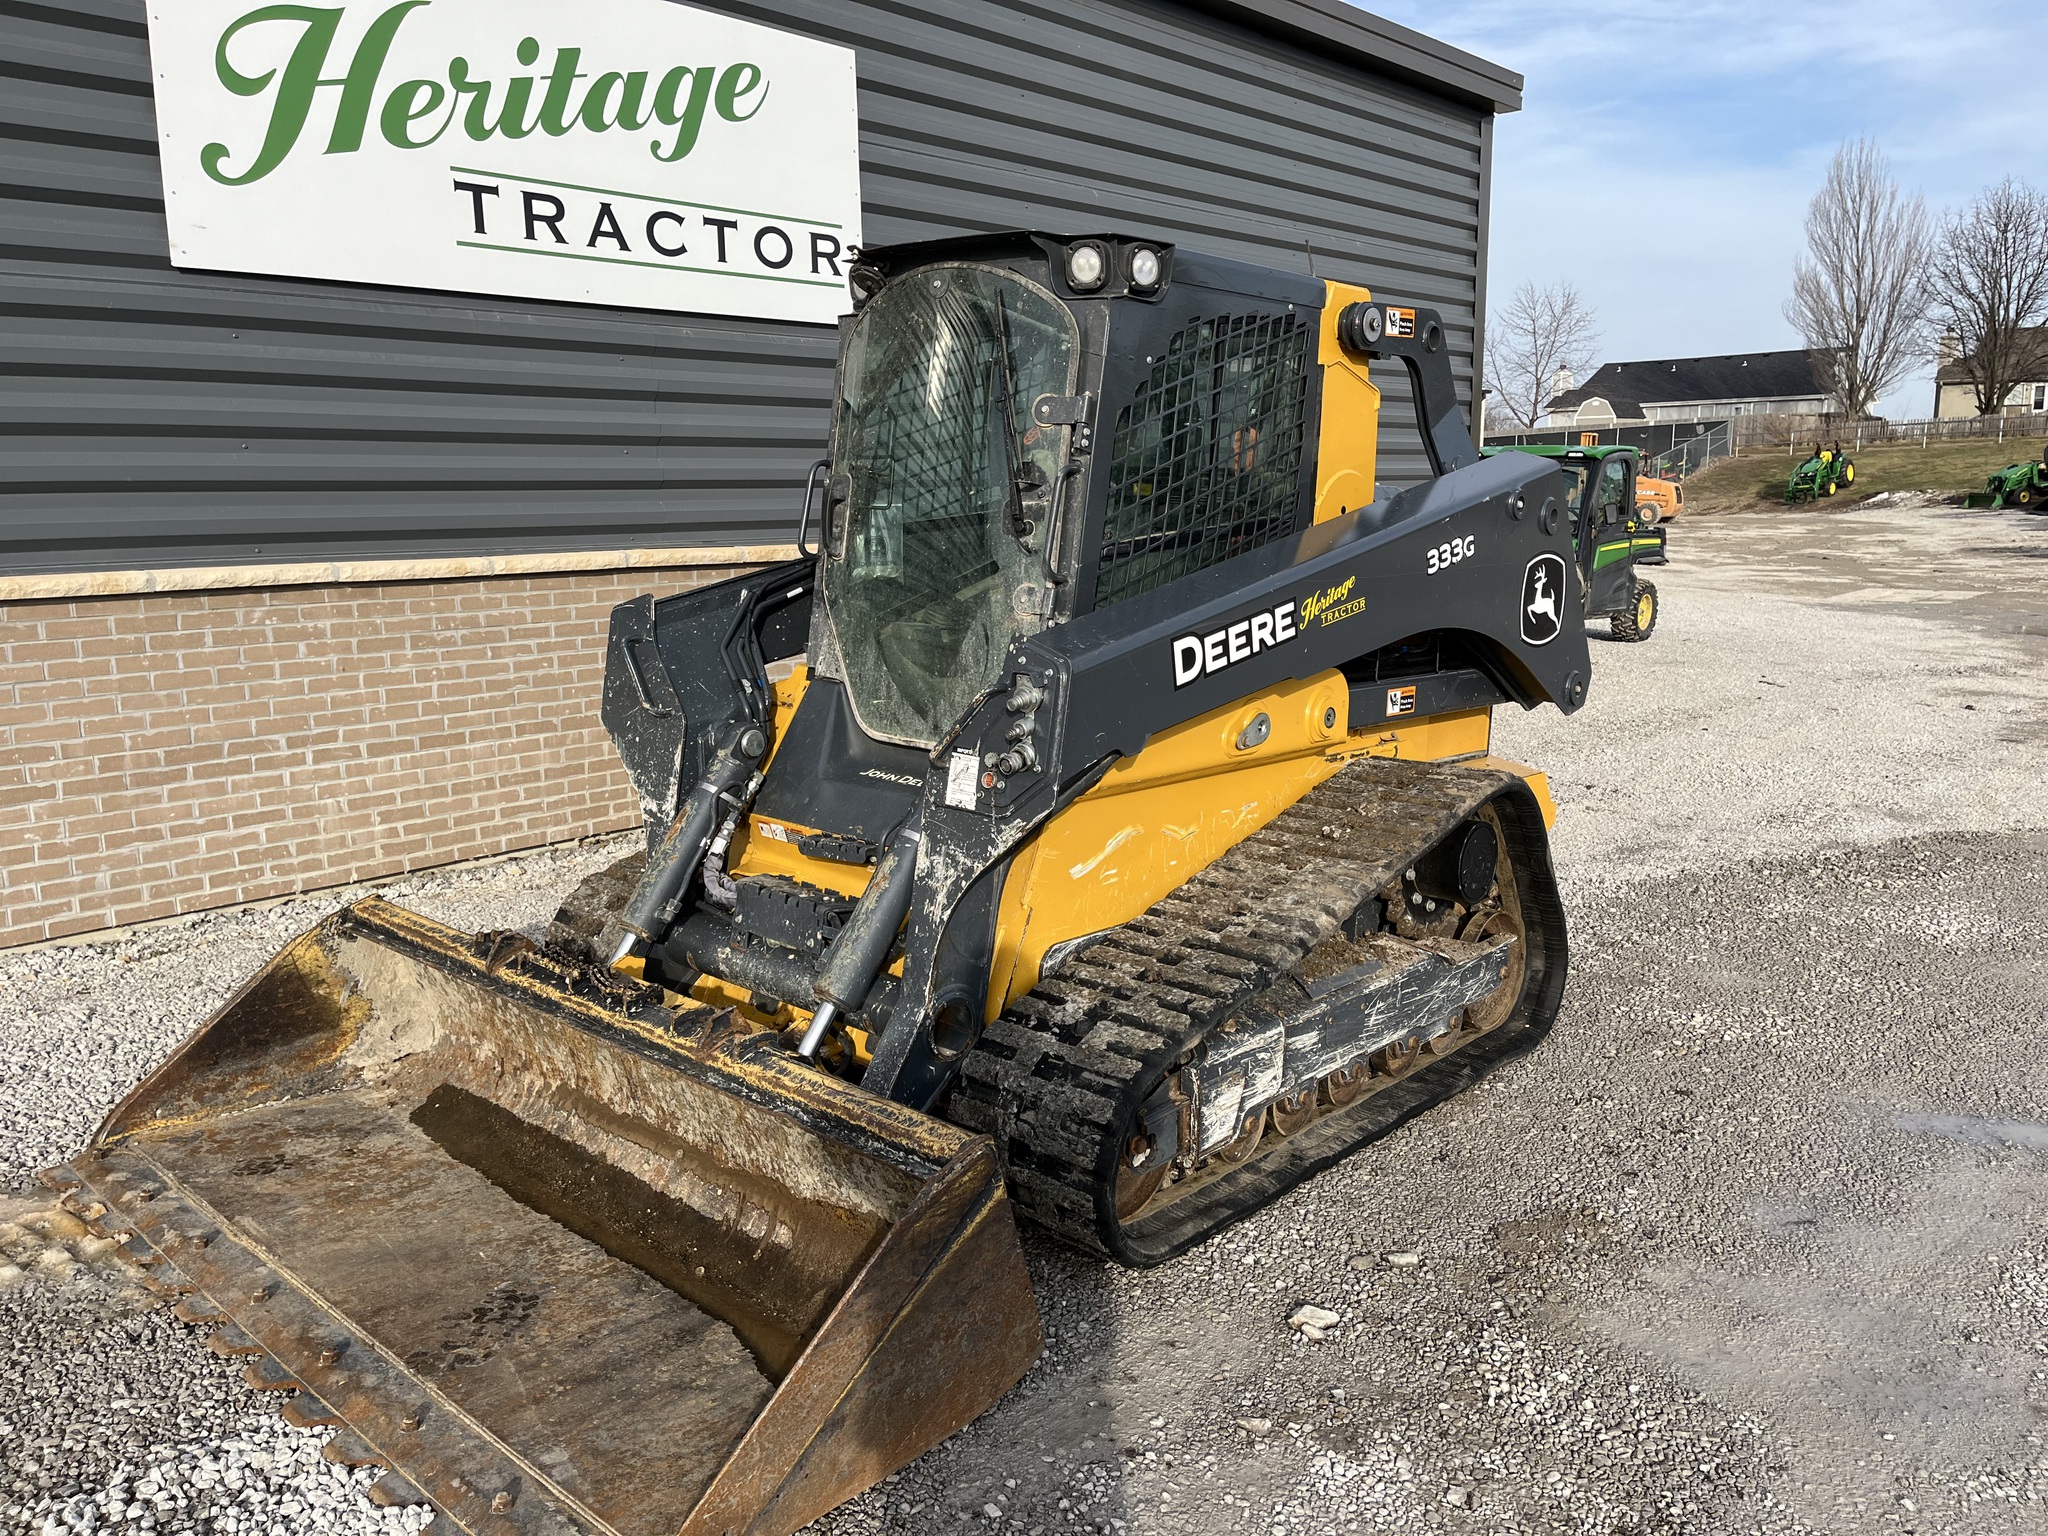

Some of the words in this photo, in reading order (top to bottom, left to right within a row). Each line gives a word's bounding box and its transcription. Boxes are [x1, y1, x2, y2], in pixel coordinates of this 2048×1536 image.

[200, 0, 770, 186] Heritage
[453, 178, 843, 277] TRACTOR
[1427, 535, 1475, 574] 333G
[1299, 575, 1357, 631] Heritage
[1320, 599, 1366, 624] TRACTOR
[1173, 601, 1296, 687] DEERE
[859, 768, 900, 782] JOHN
